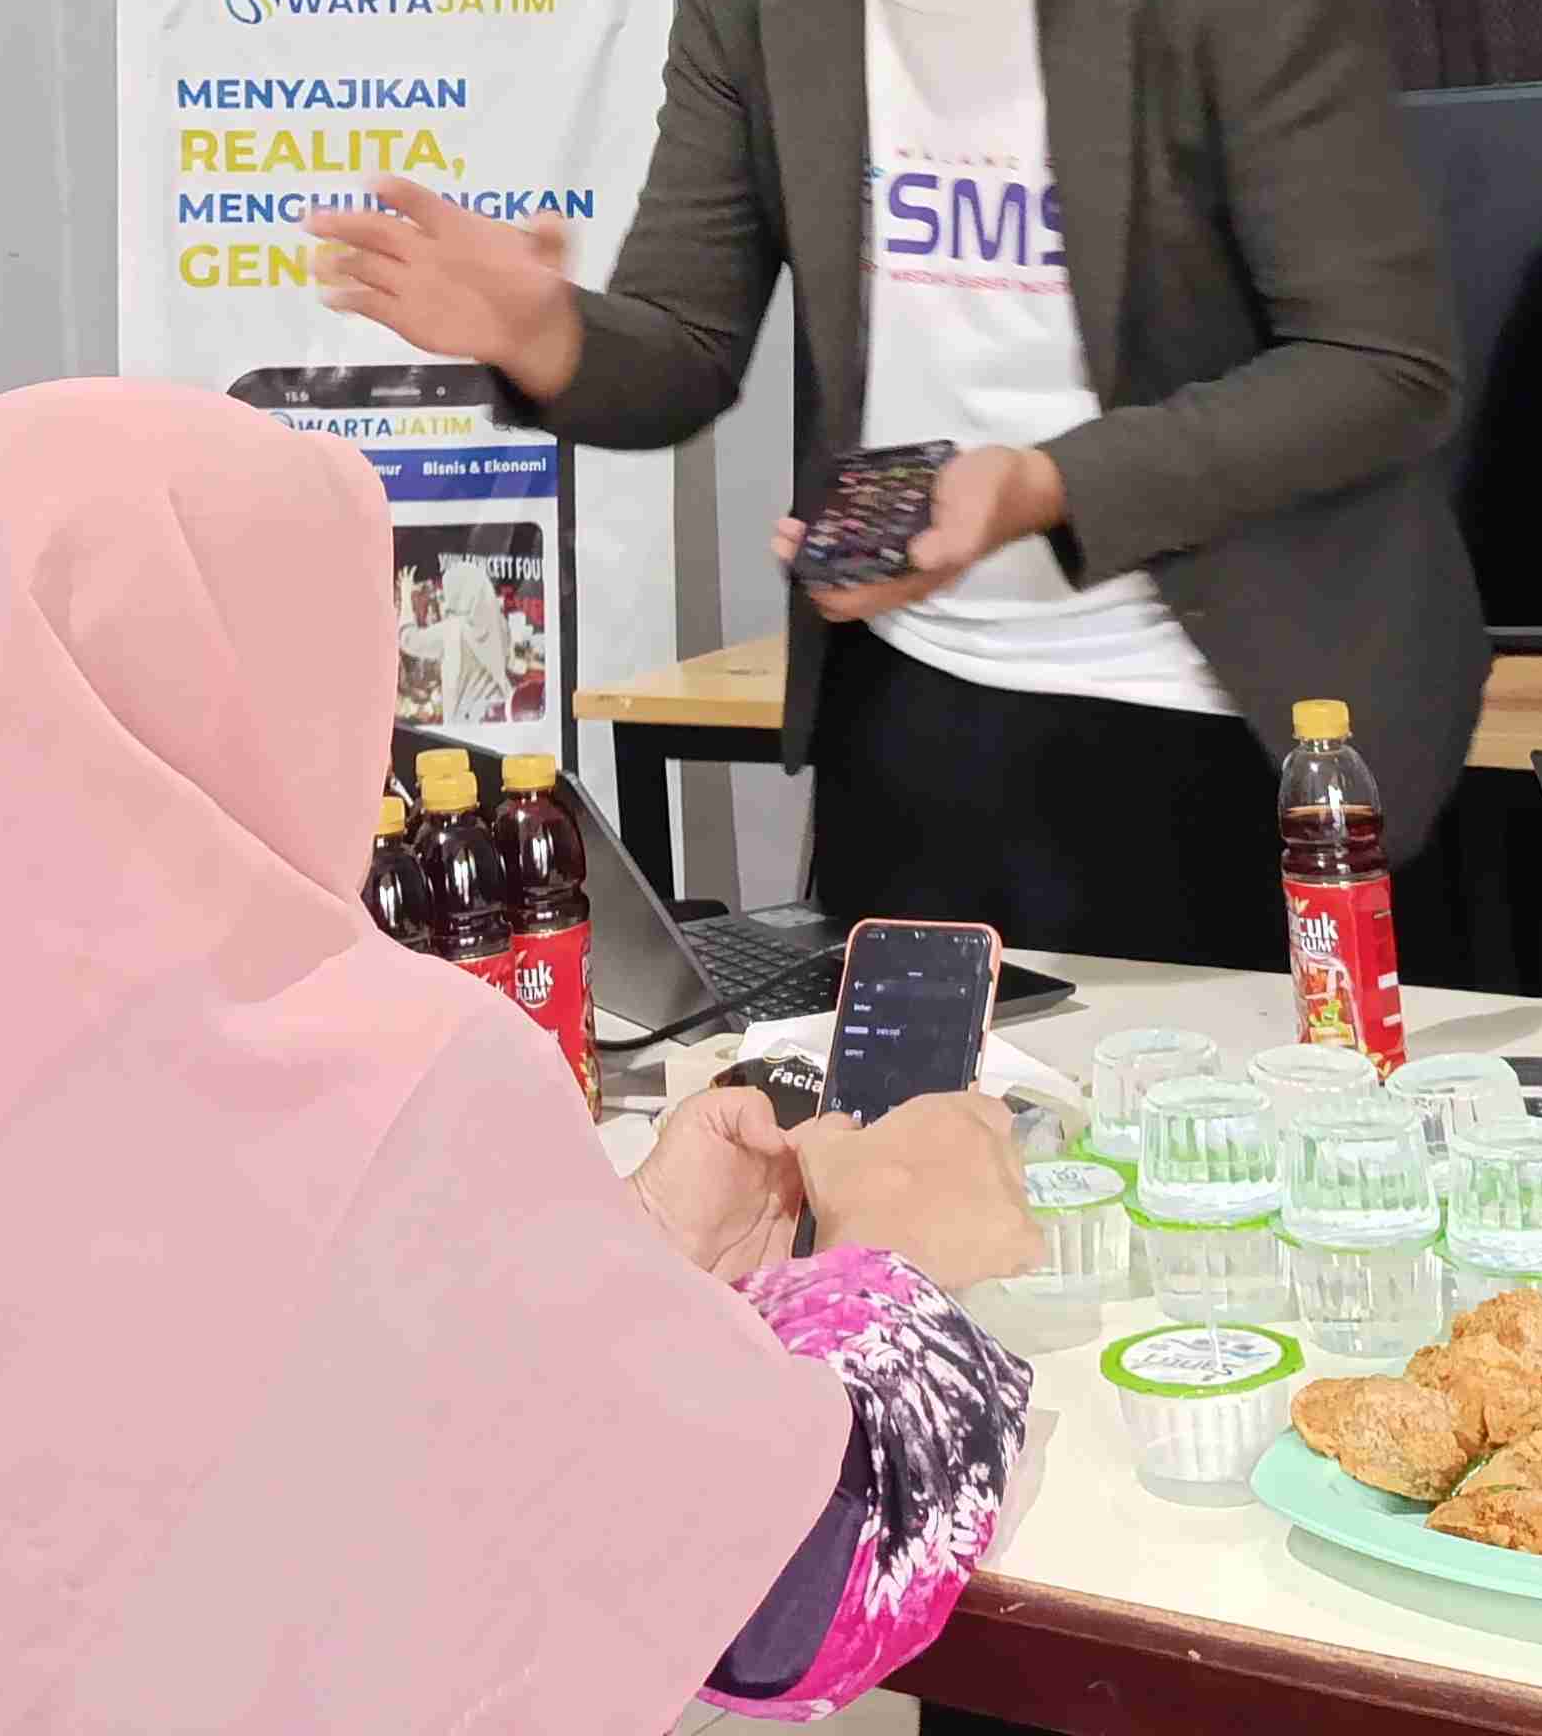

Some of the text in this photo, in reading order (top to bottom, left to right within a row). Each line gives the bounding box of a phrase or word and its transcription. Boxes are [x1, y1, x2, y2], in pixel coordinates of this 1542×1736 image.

[177, 78, 467, 109] MENYAJIKAN
[180, 128, 466, 179] REALITA,
[422, 460, 466, 476] Bisnis
[469, 461, 481, 475] &
[483, 457, 547, 474] Ekonomi
